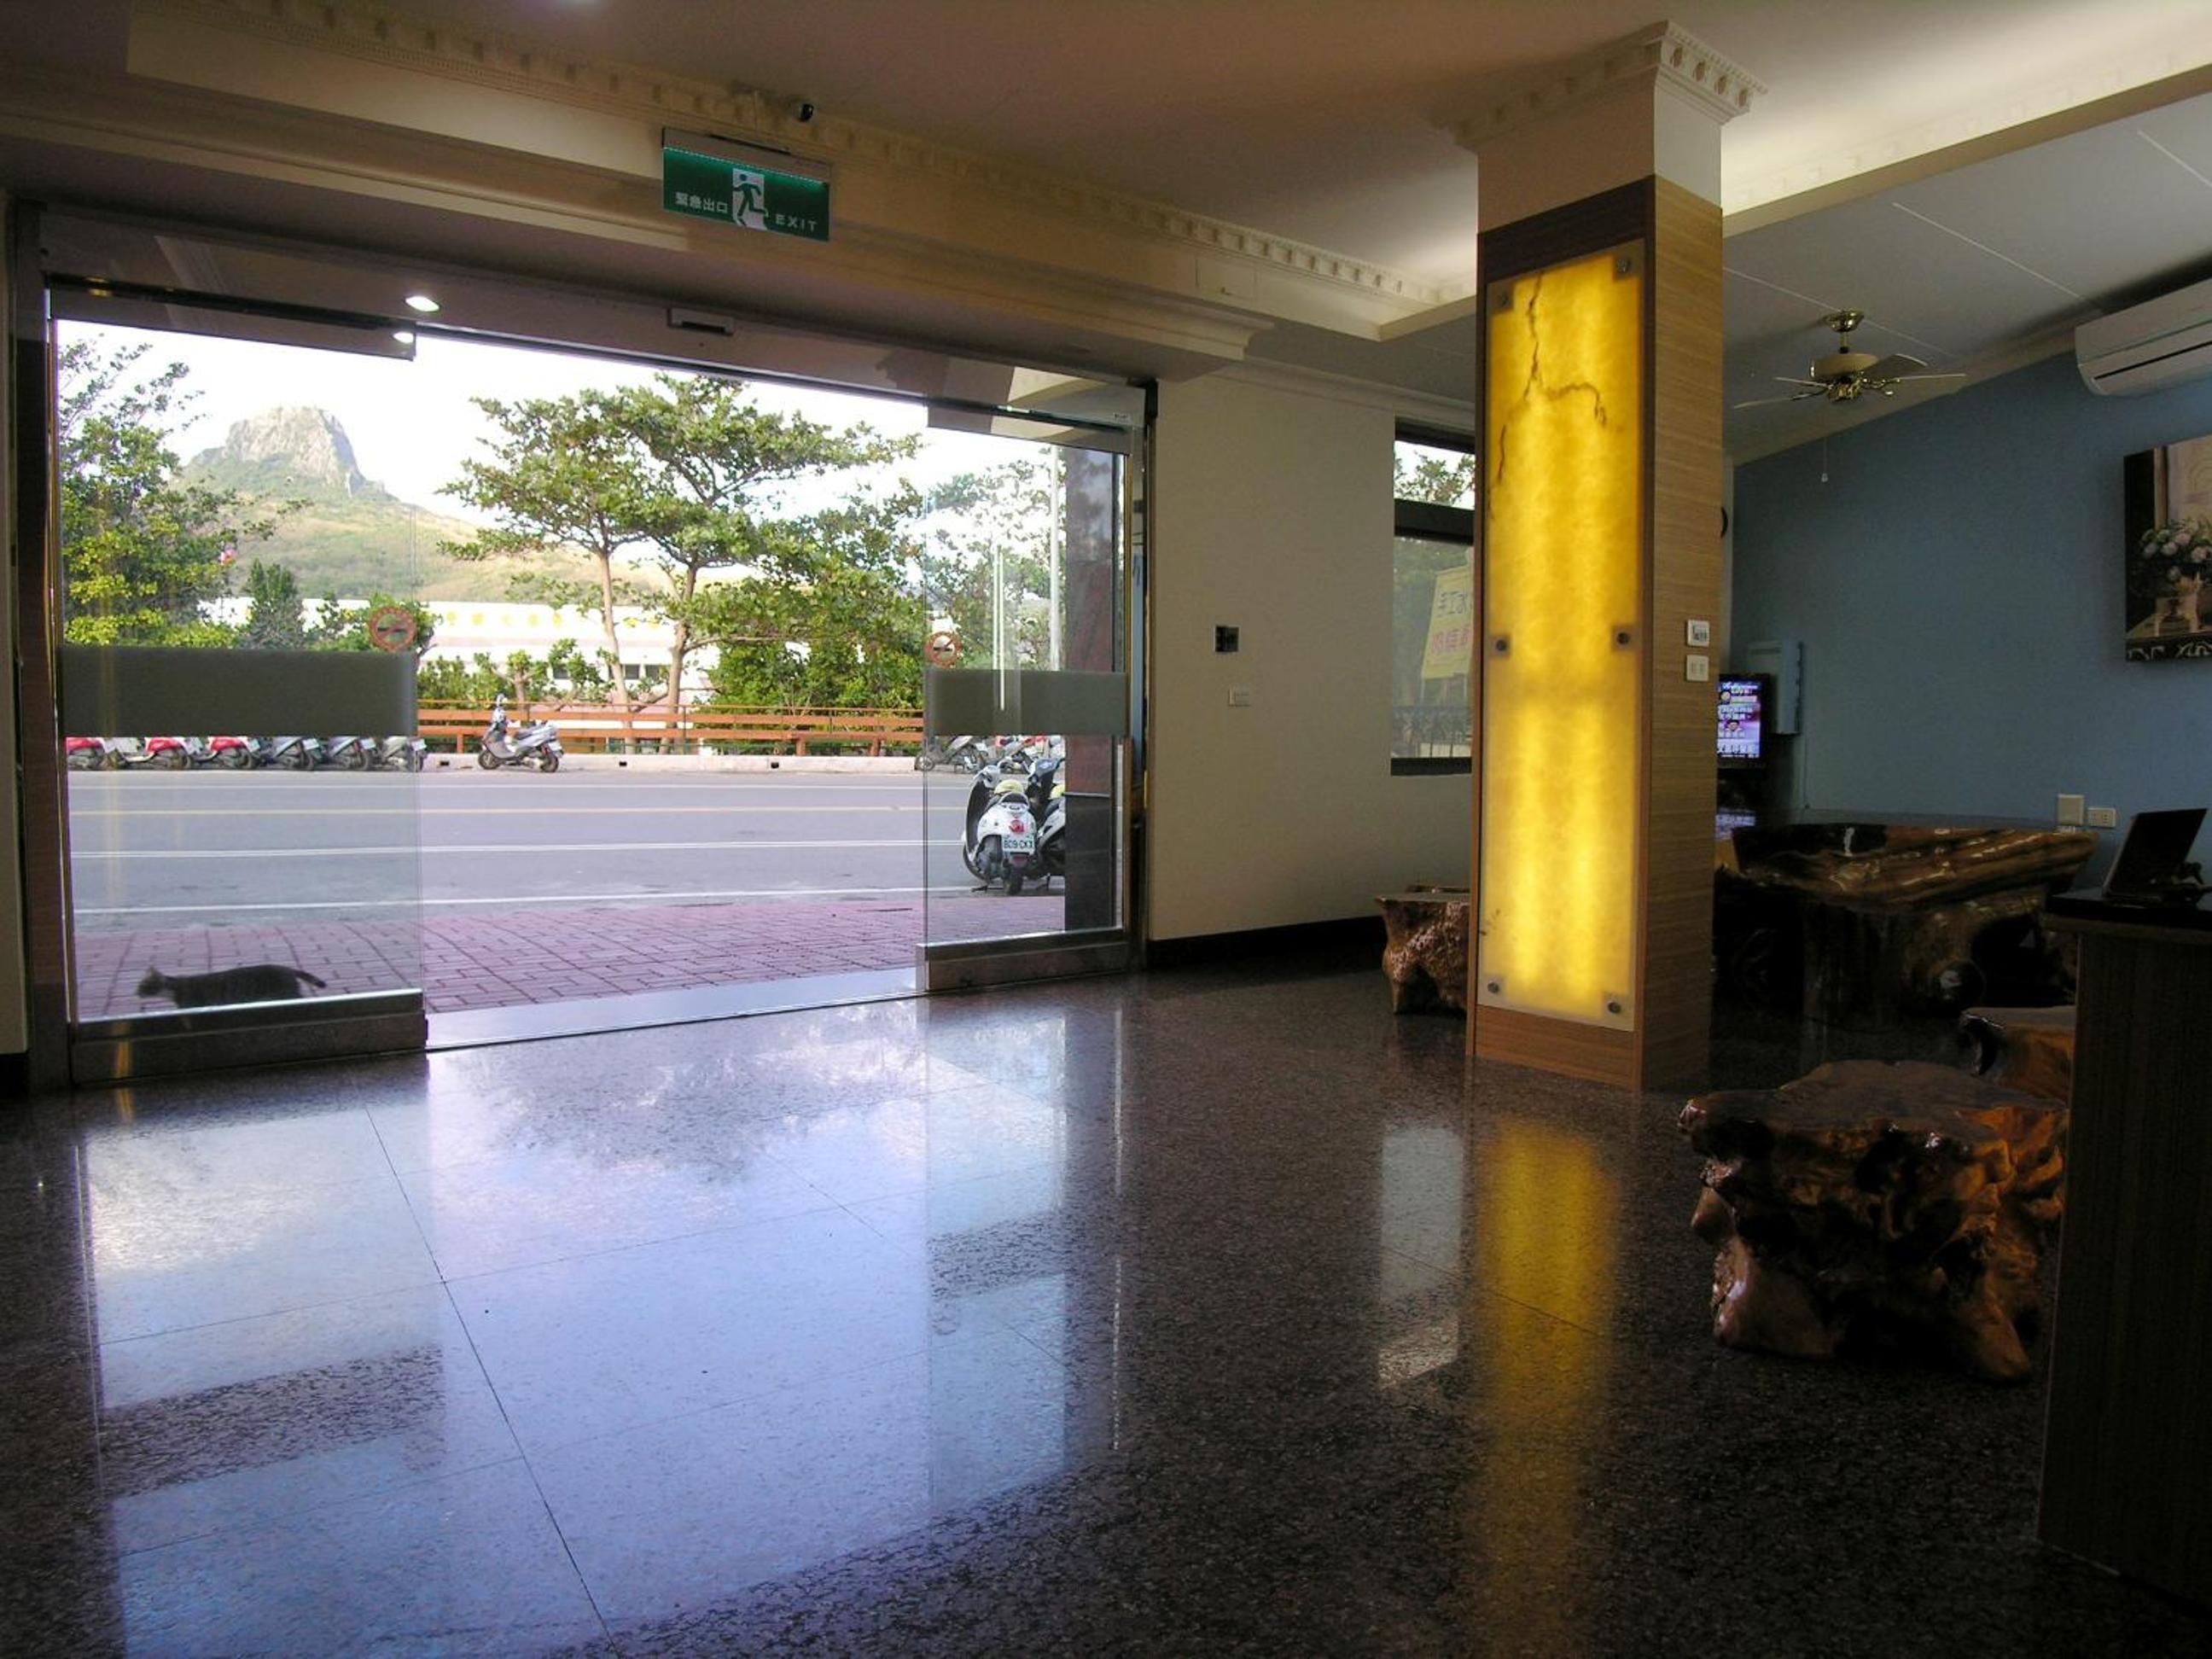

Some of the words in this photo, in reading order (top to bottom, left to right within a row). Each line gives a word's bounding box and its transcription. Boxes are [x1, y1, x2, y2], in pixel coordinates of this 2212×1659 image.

[675, 192, 728, 213] 緊急出口
[775, 214, 818, 232] EXIT
